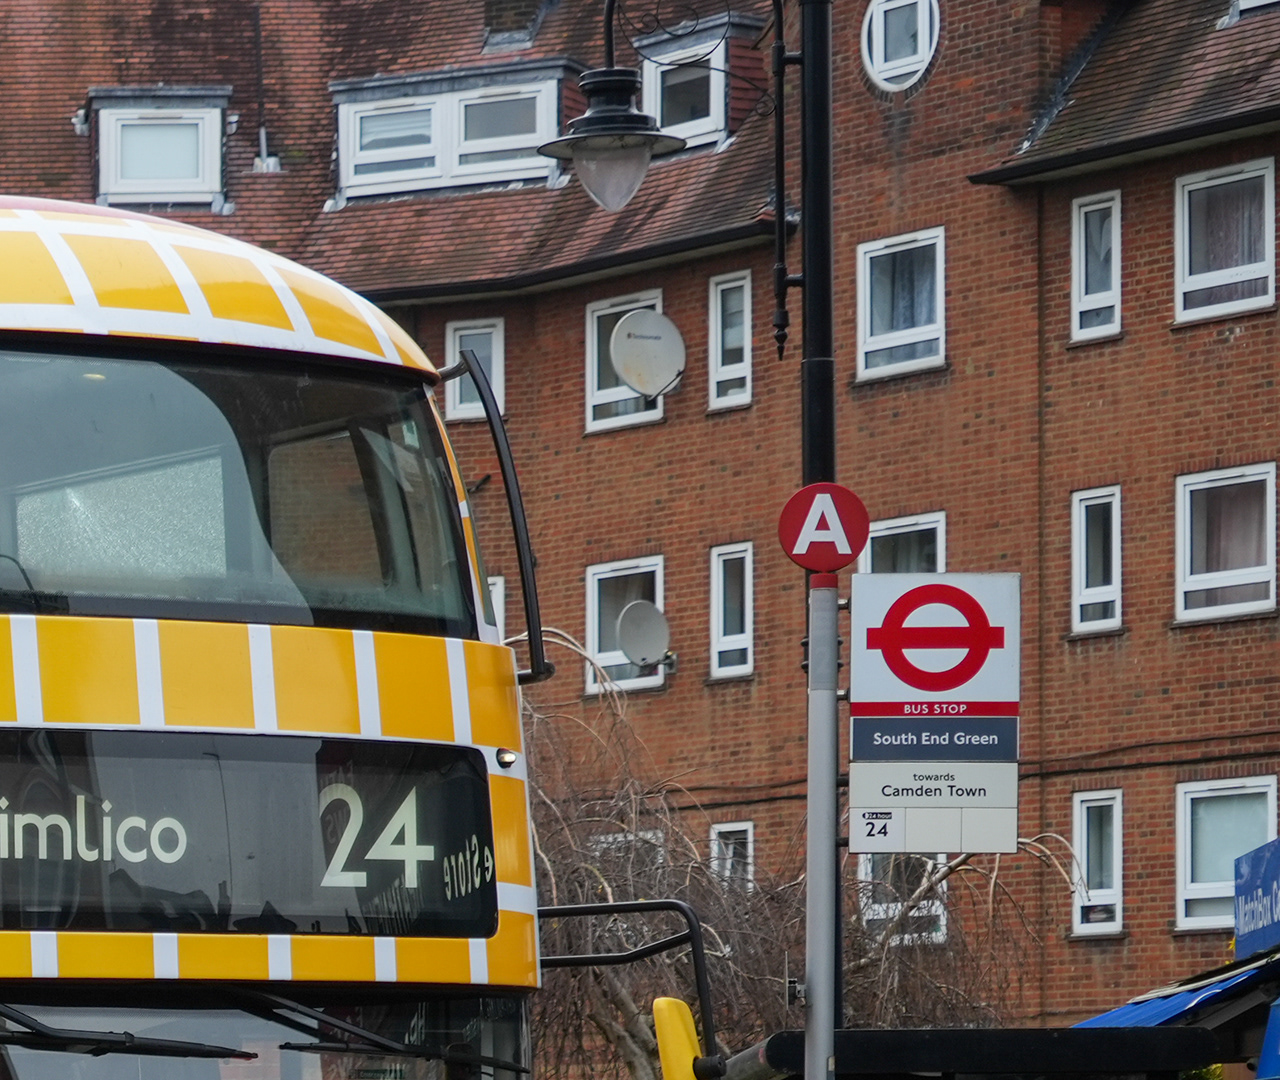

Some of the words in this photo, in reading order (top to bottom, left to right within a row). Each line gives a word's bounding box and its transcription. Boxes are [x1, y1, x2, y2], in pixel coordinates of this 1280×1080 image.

[791, 492, 853, 555] A
[904, 704, 929, 714] BUS
[934, 704, 967, 714] STOP
[873, 732, 917, 745] South
[921, 732, 949, 745] End
[953, 732, 998, 745] Green
[913, 773, 956, 782] towards
[881, 785, 942, 797] Camden
[947, 785, 987, 797] Town
[319, 783, 435, 888] 24
[865, 822, 889, 837] 24
